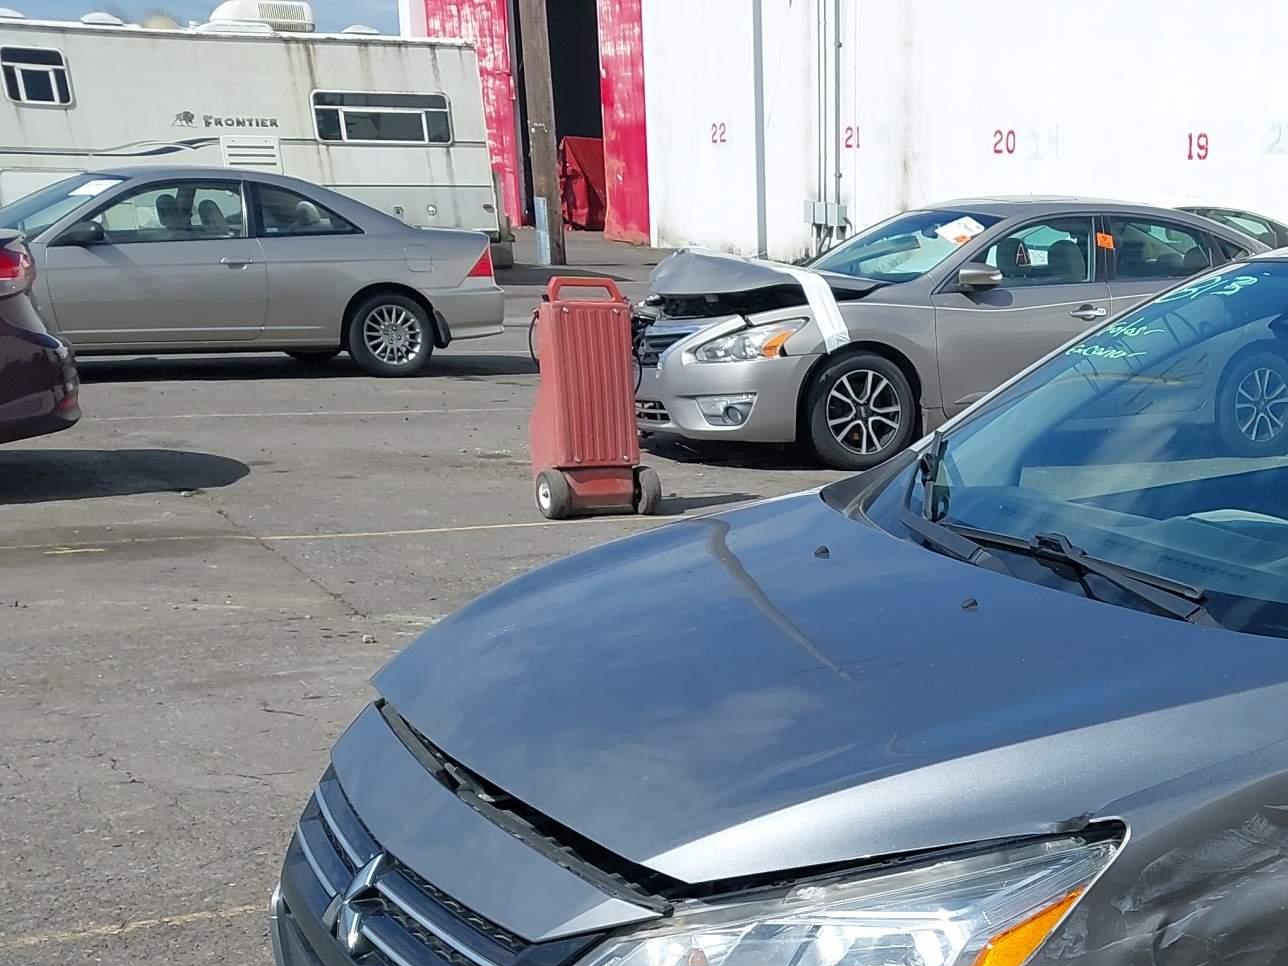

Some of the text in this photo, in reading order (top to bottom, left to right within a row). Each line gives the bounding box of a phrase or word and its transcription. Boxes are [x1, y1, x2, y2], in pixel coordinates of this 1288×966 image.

[202, 114, 280, 129] FRONTIER
[711, 122, 727, 143] 22
[844, 126, 860, 149] 21
[992, 129, 1016, 154] 20
[1187, 132, 1209, 160] 19
